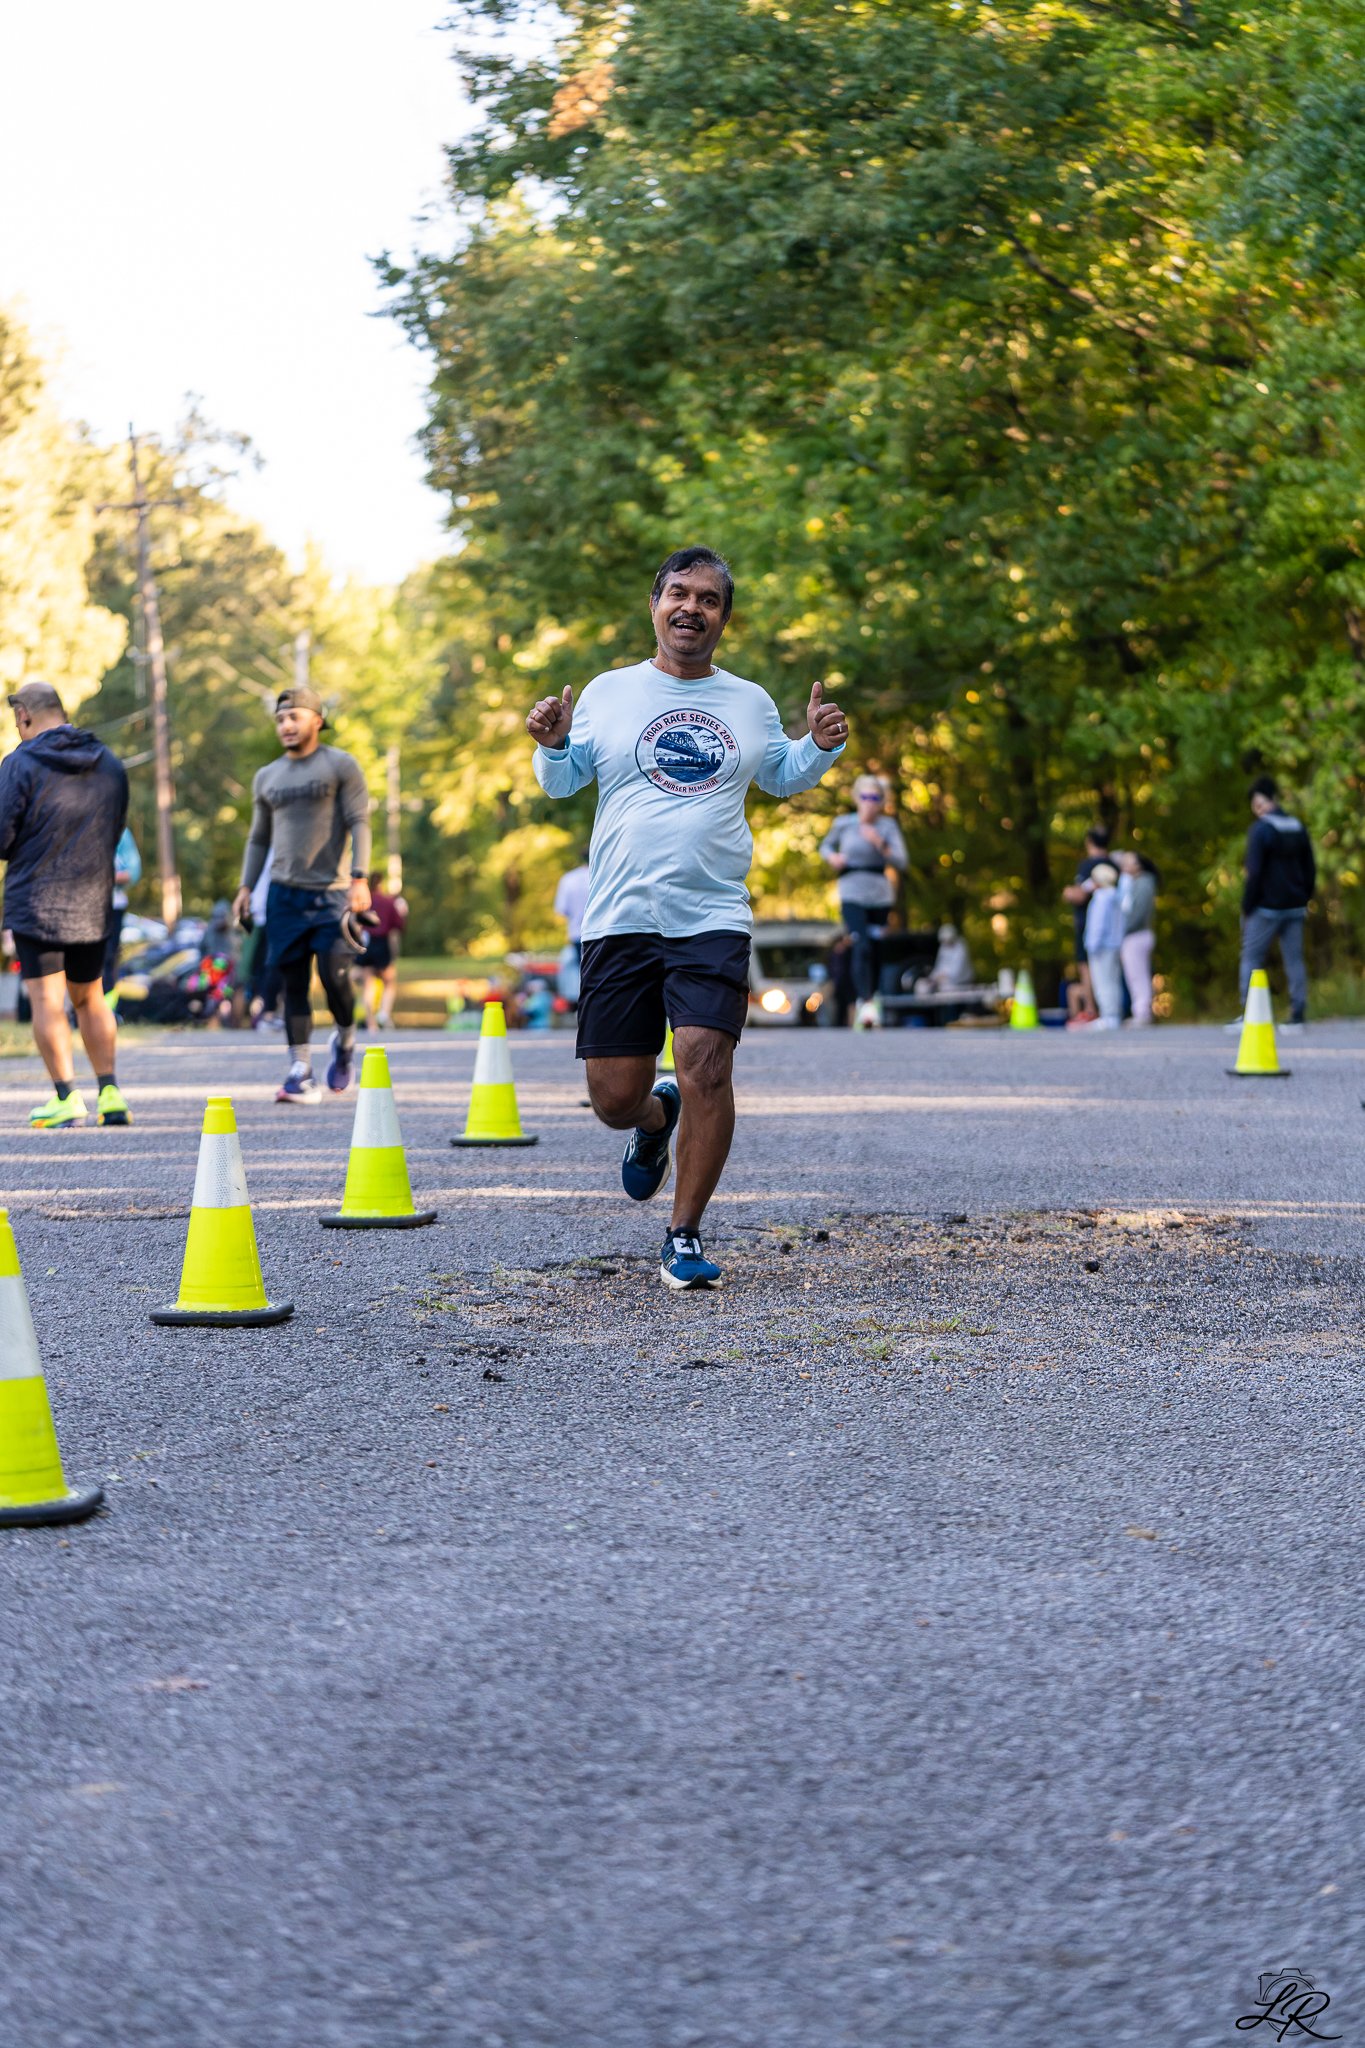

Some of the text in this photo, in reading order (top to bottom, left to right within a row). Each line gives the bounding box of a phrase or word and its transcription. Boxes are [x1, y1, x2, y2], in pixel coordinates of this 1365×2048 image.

[643, 712, 736, 750] ROAD RACE SERIES 2026
[267, 779, 330, 805] CrFit
[663, 780, 687, 793] PURSER
[688, 778, 719, 793] MEMORIAL
